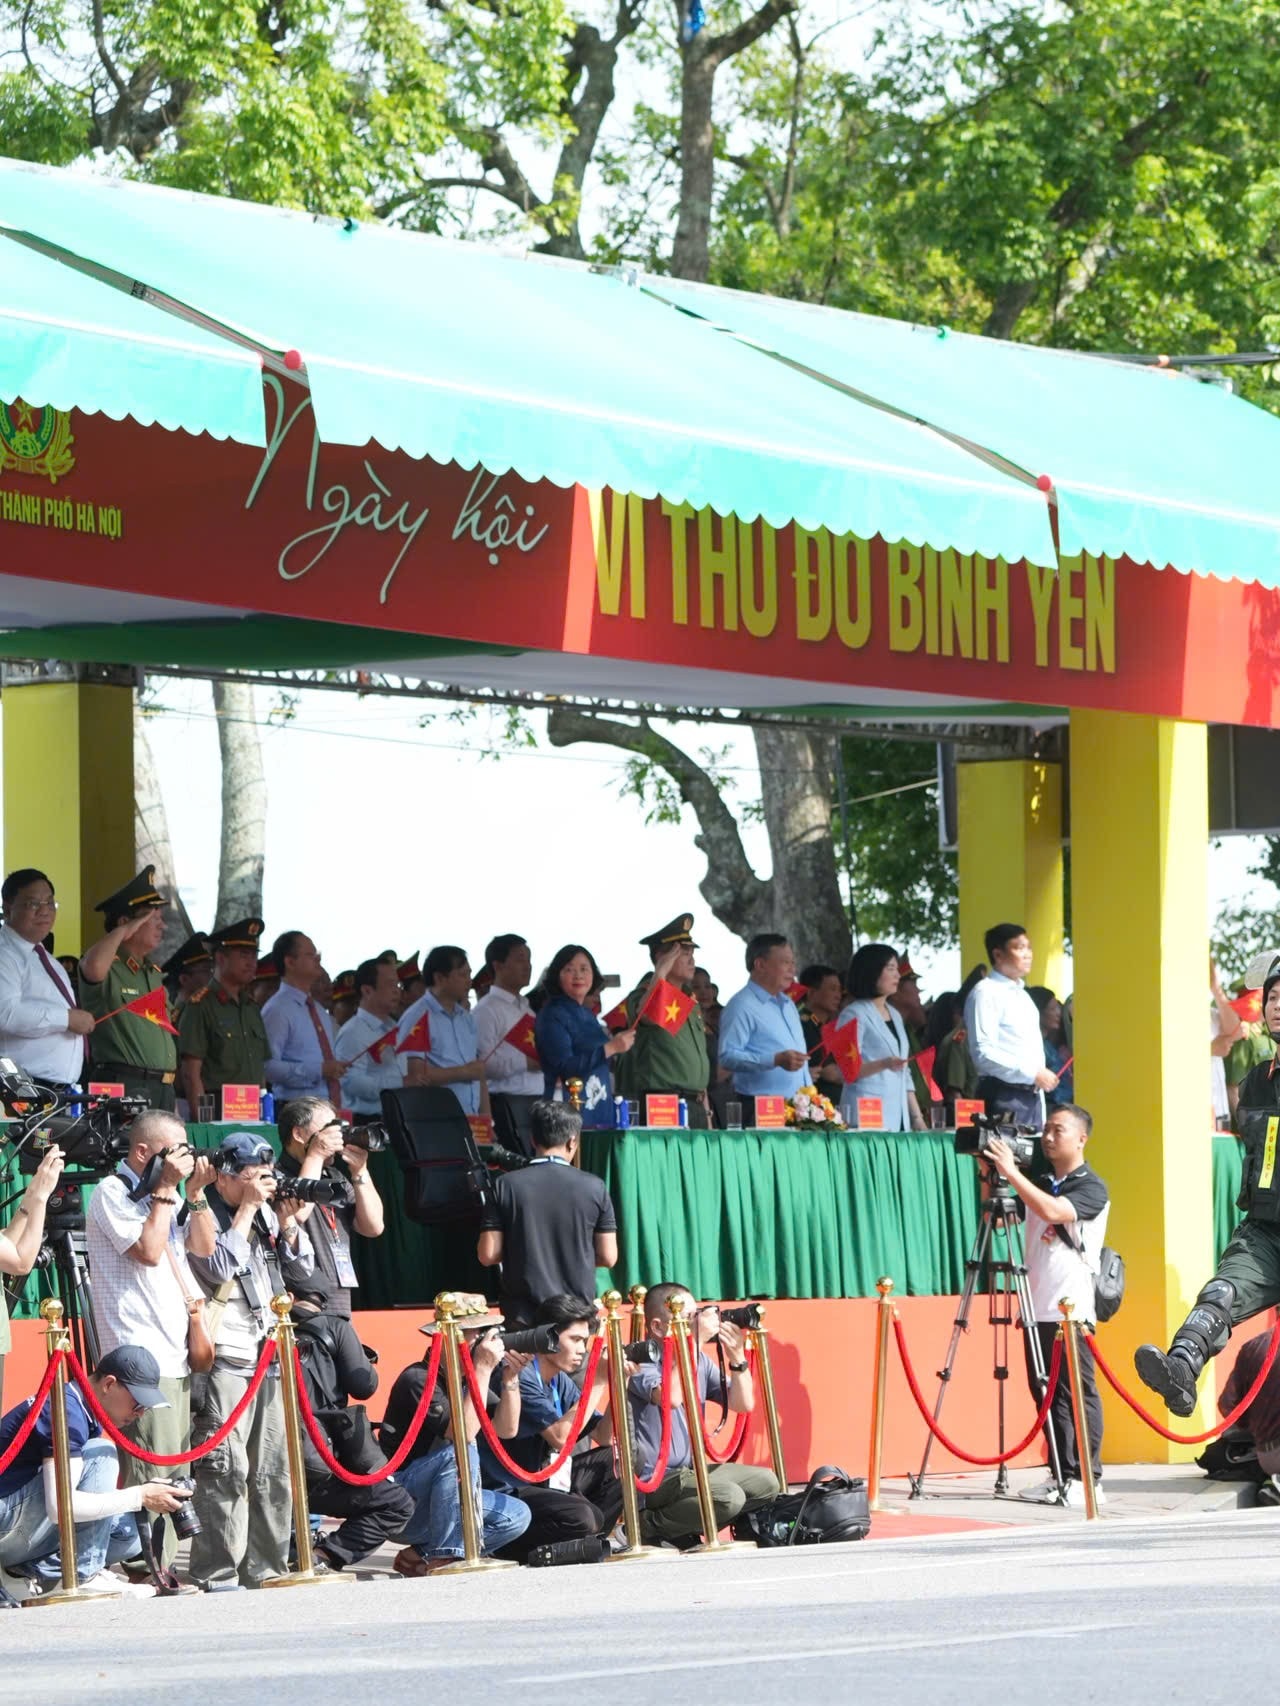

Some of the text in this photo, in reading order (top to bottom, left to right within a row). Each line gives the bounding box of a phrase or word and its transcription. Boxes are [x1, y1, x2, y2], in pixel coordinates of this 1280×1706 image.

[44, 495, 73, 530] PHỐ
[76, 501, 95, 533] HÀ
[98, 505, 122, 541] NỘI
[245, 373, 549, 604] Ngày hội
